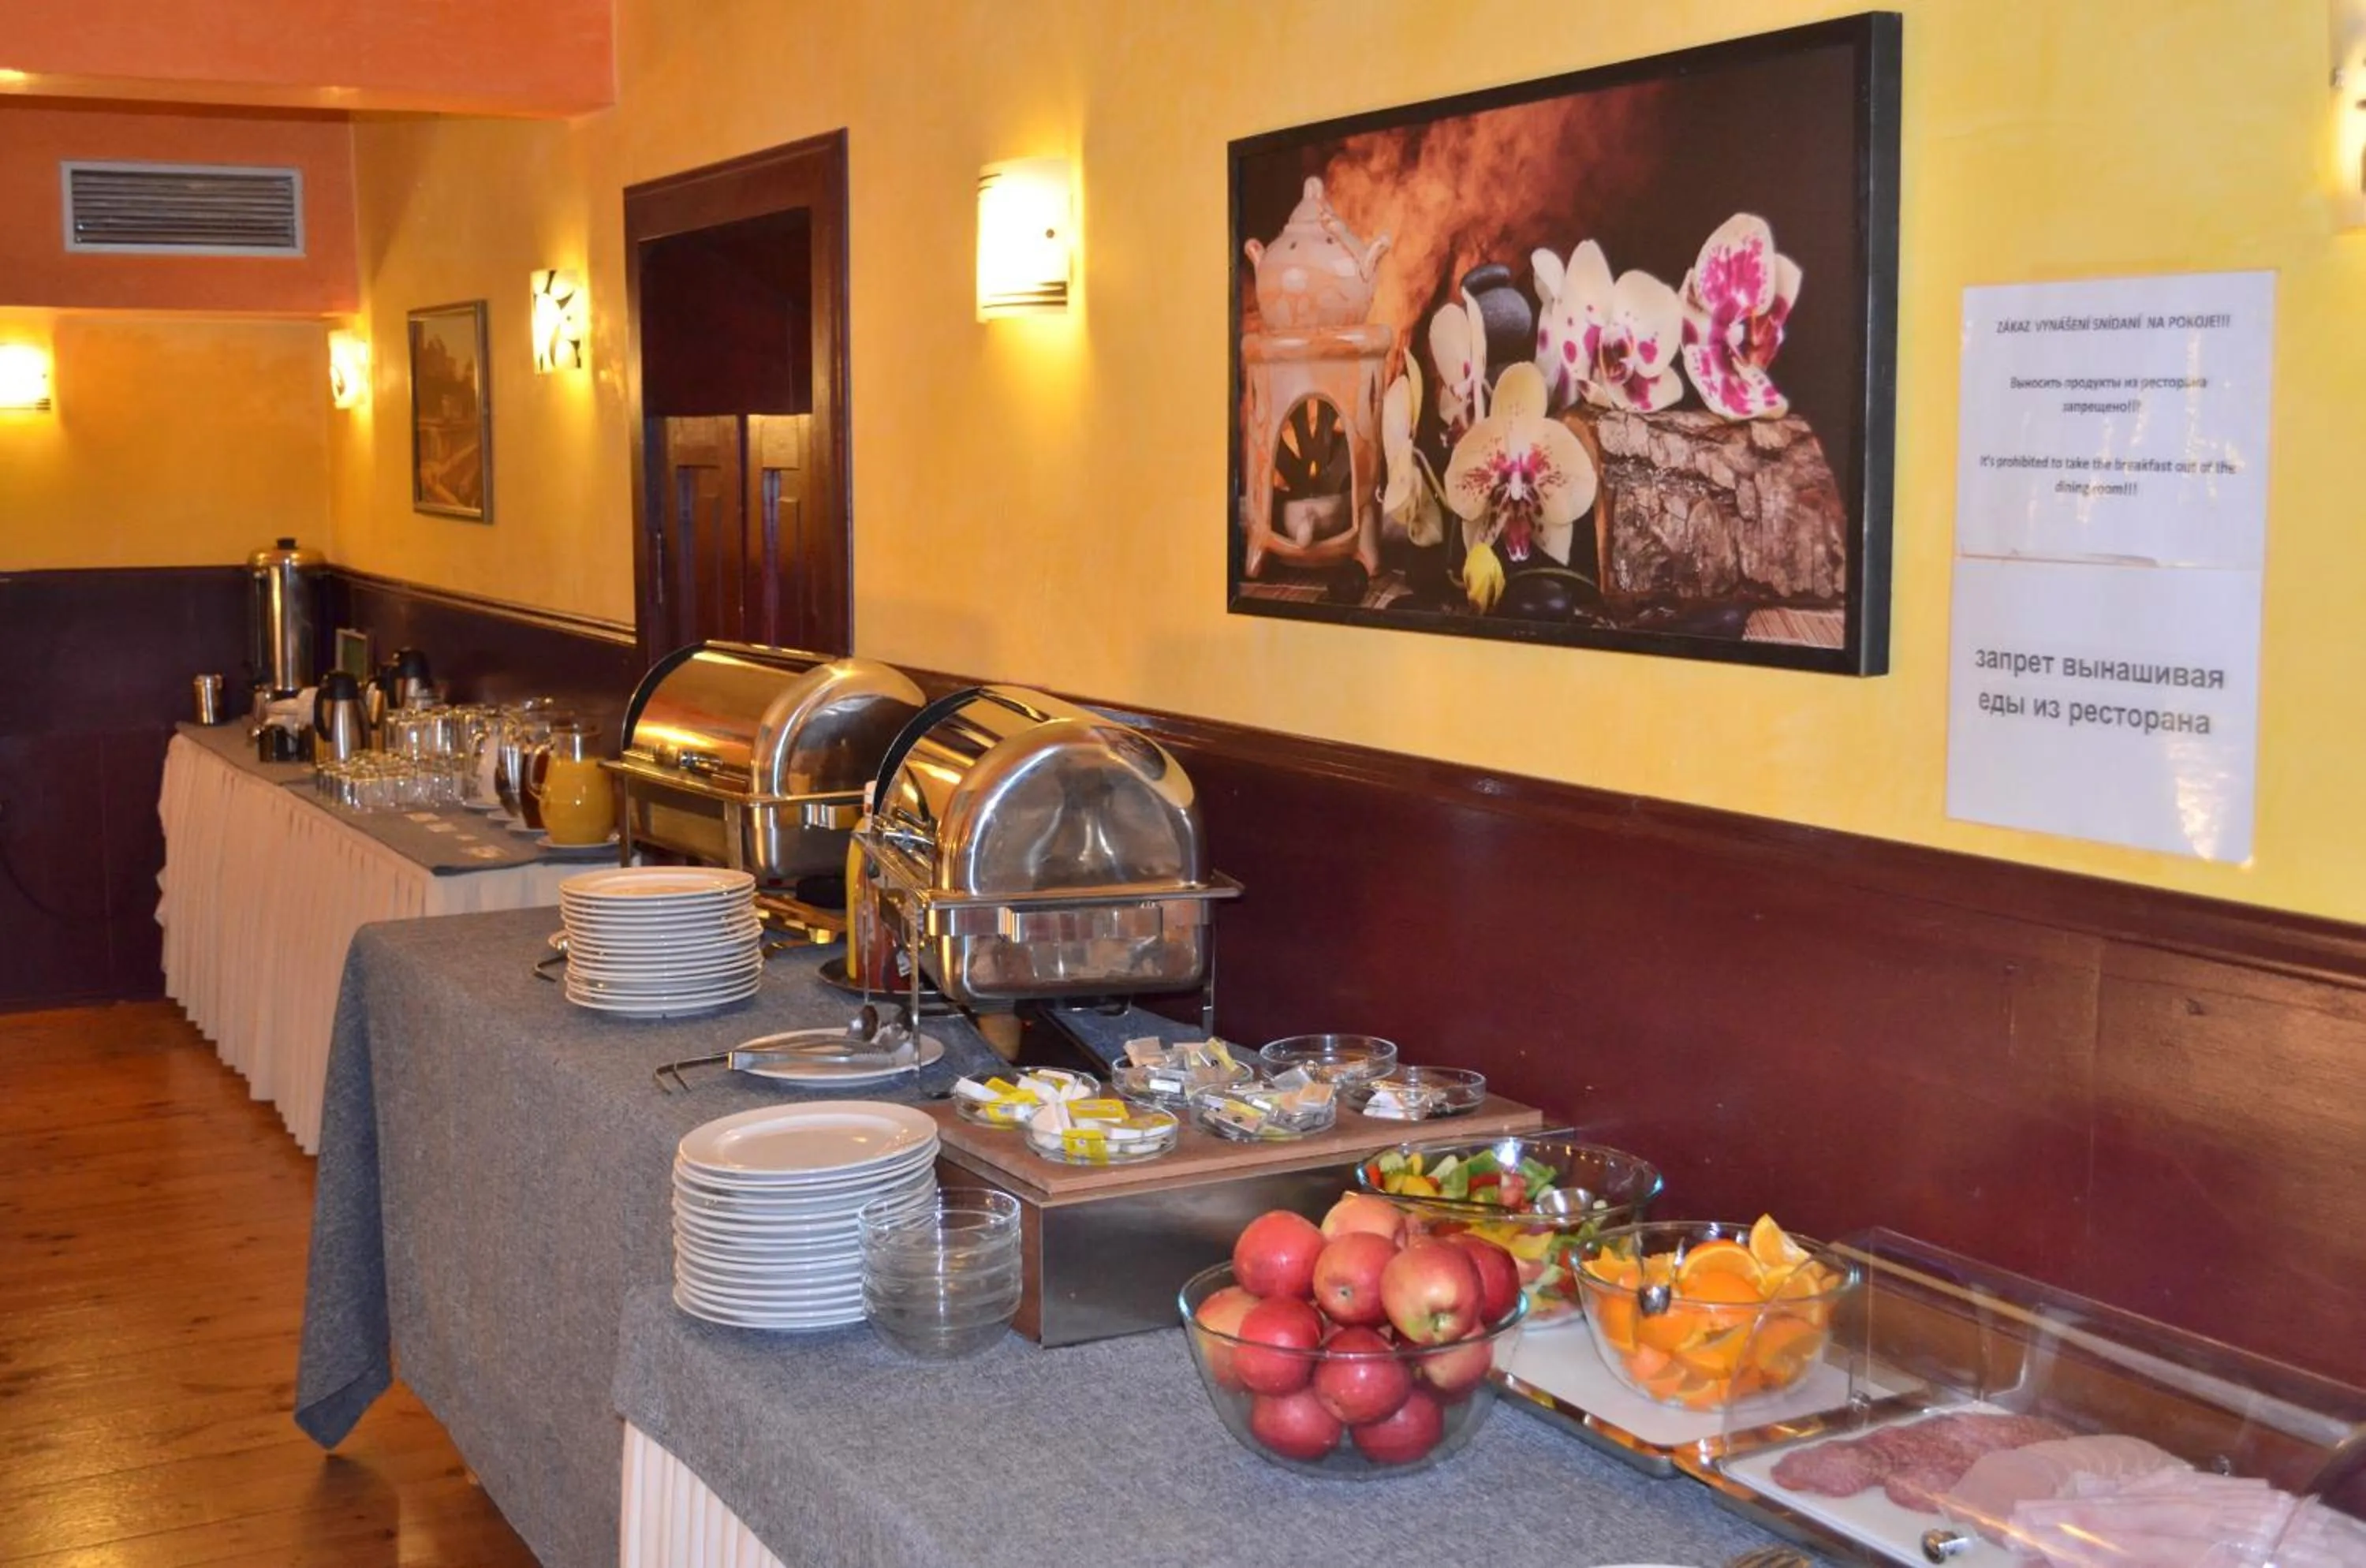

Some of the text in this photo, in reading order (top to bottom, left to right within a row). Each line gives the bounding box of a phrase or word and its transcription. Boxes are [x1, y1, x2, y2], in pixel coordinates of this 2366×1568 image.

[2147, 315, 2165, 329] NA
[2169, 314, 2231, 329] POKOJE!!!
[2010, 376, 2062, 390] Выносить
[2064, 379, 2121, 390] продукты
[1996, 455, 2049, 469] prohibited
[2051, 457, 2062, 469] to
[2066, 456, 2089, 469] take
[2092, 457, 2111, 470] the
[2054, 480, 2090, 497] dining
[1975, 647, 2225, 690] запрет вынашивая
[1978, 691, 2211, 736] еды из ресторана
